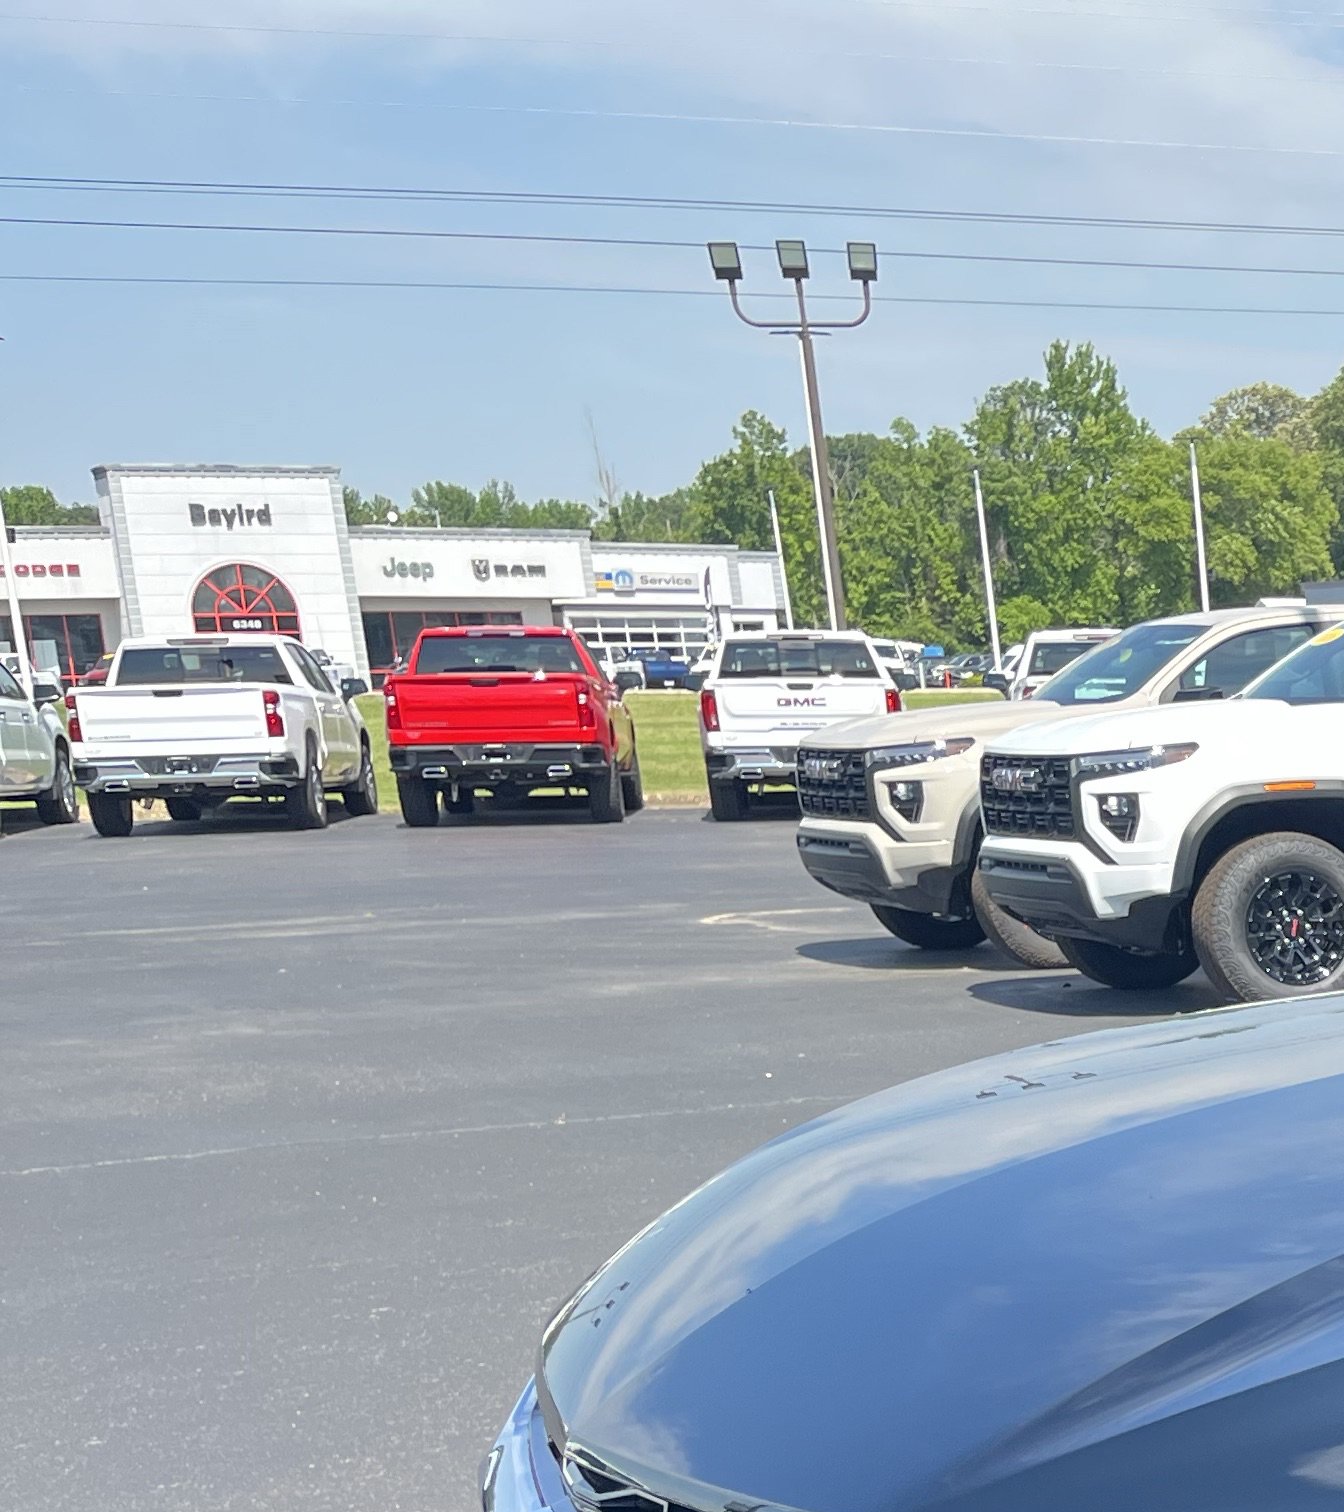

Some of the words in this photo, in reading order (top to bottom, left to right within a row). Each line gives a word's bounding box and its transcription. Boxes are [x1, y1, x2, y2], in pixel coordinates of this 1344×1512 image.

[188, 503, 272, 531] Bayird
[382, 556, 435, 582] Jeep
[640, 575, 692, 585] Service
[776, 697, 827, 707] GMC
